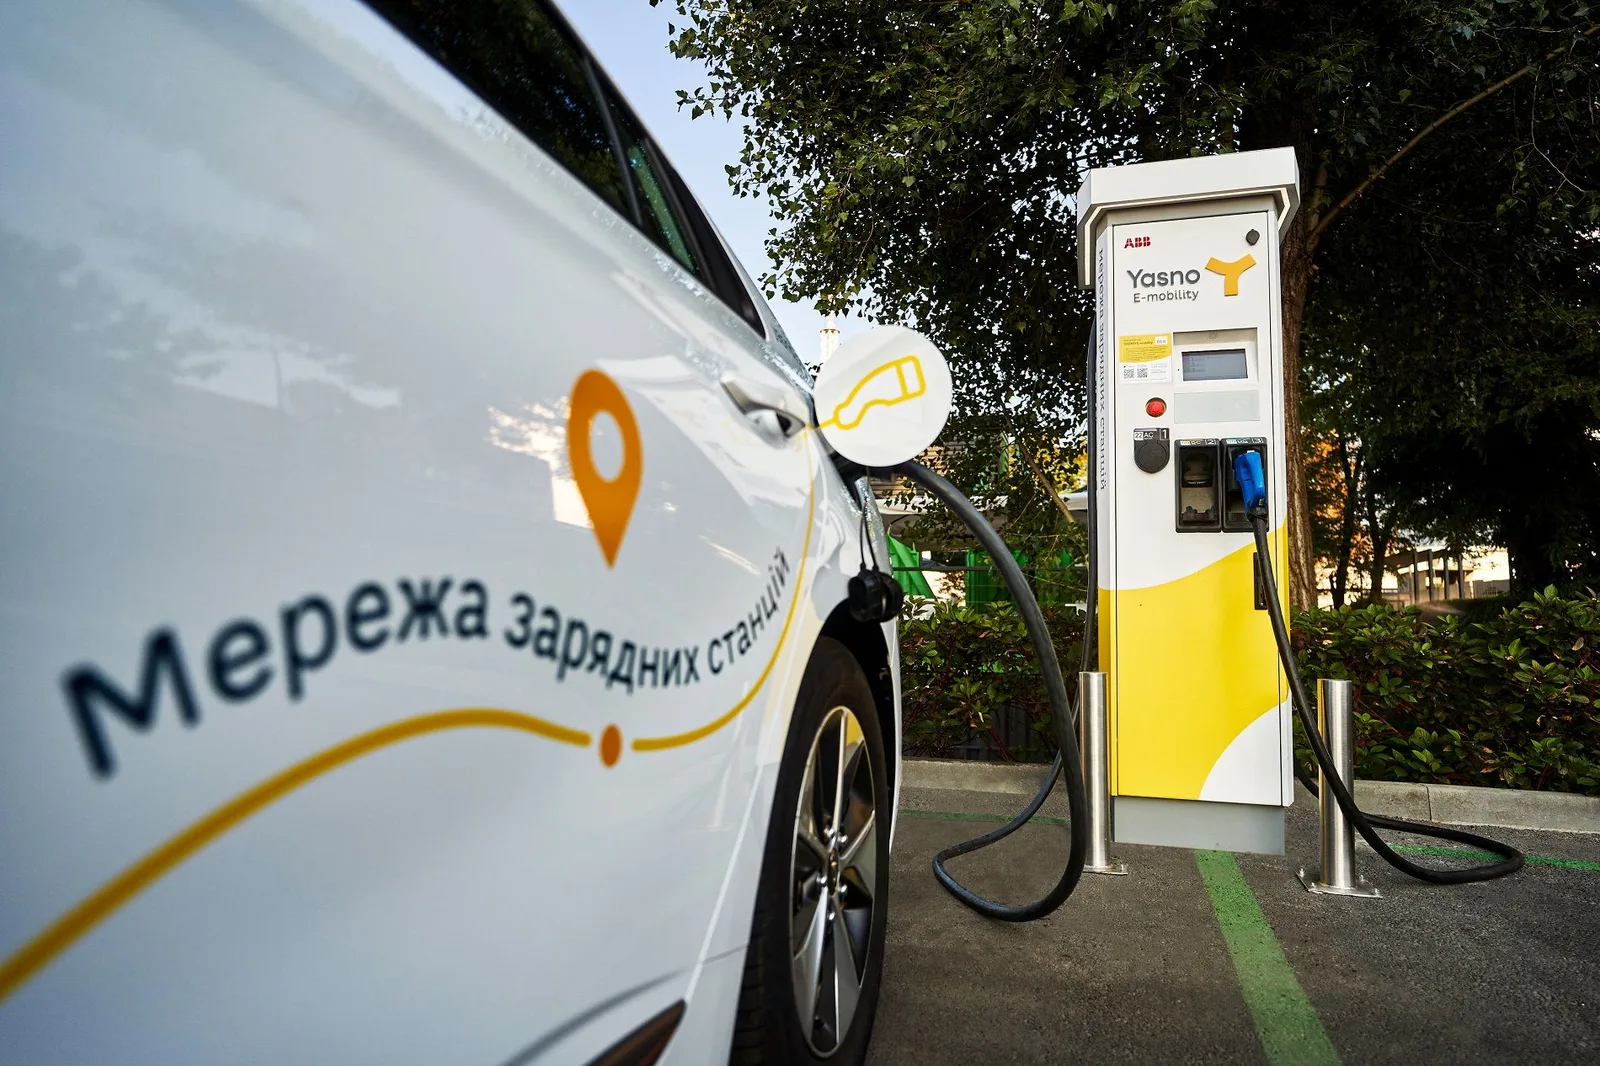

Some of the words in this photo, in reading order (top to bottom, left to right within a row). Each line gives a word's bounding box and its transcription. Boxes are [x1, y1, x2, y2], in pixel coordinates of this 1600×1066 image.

[1124, 236, 1151, 249] ABB
[1126, 268, 1201, 289] Yasno
[1133, 289, 1199, 303] E-mobility
[503, 591, 701, 696] зарядних
[707, 546, 791, 674] станцій
